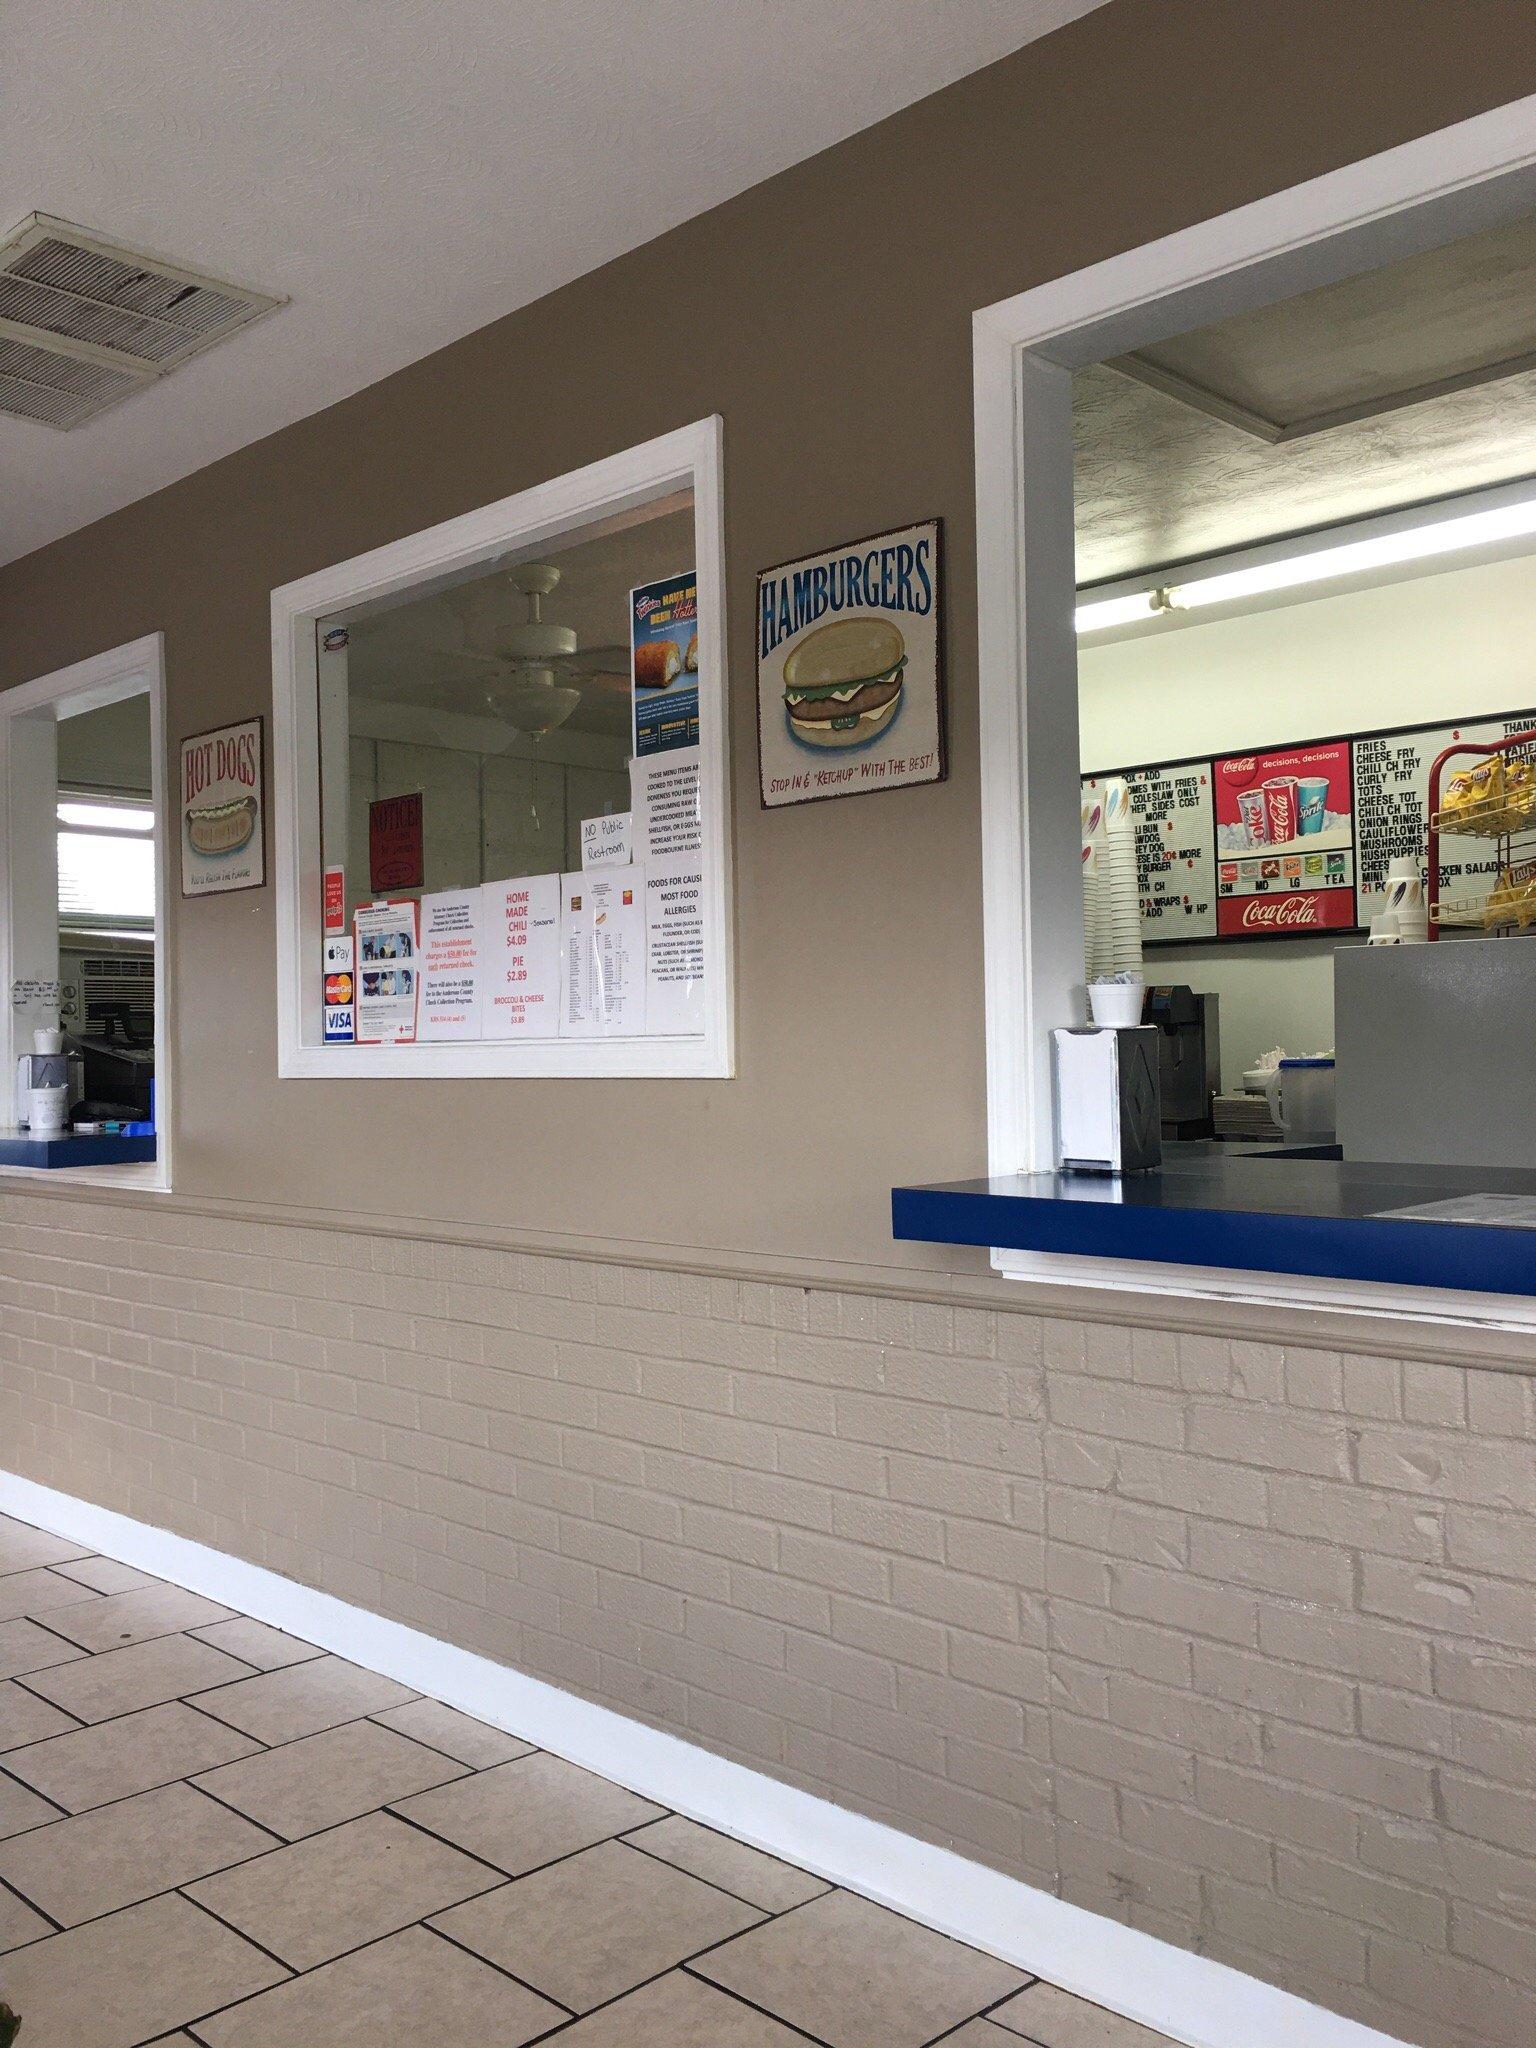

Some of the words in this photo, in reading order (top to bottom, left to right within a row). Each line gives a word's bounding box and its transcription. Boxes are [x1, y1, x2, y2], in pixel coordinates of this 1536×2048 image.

[761, 539, 931, 659] HAMBURGERS
[672, 599, 697, 619] Hotte
[1357, 741, 1386, 753] FRIES
[1263, 757, 1300, 768] decisions,
[1303, 751, 1339, 762] decisions
[1356, 751, 1391, 764] CHEESE
[1397, 747, 1414, 759] FRY
[186, 742, 213, 803] HOT
[217, 733, 255, 786] DOGS
[649, 771, 662, 779] THESE
[663, 769, 677, 777] MENU
[678, 766, 691, 774] ITEMS
[1357, 763, 1381, 775] CHILI
[1386, 761, 1398, 771] CH
[1403, 758, 1421, 769] FRY
[770, 778, 789, 793] STOP
[792, 775, 800, 789] IN
[804, 771, 810, 789] &
[813, 767, 859, 786] "KETCHUP"
[861, 762, 885, 777] WITH
[888, 759, 905, 775] THE
[909, 753, 933, 772] BEST!
[1144, 771, 1160, 781] ADD
[1357, 773, 1387, 786] CURLY
[1395, 770, 1412, 781] FRY
[647, 783, 666, 791] COOKED
[1151, 781, 1171, 791] WITH
[1175, 777, 1197, 787] FRIES
[1200, 776, 1206, 784] &
[1133, 794, 1173, 803] COLESLAW
[1178, 787, 1197, 797] ONLY
[1358, 785, 1382, 796] TOTS
[647, 793, 671, 801] DONENESS
[1358, 794, 1394, 807] CHEESE
[1399, 792, 1416, 802] TOT
[652, 803, 680, 811] CONSUMING
[1152, 800, 1175, 811] SIDES
[1179, 797, 1200, 807] COST
[1300, 801, 1324, 819] Sprite
[1359, 806, 1383, 818] CHILI
[1388, 804, 1400, 815] CH
[1405, 802, 1422, 813] TOT
[650, 812, 684, 823] UNDERCOOKED
[1146, 811, 1167, 821] MORE
[1359, 816, 1388, 828] ONION
[1393, 813, 1422, 825] RINGS
[585, 824, 596, 837] NO
[602, 821, 624, 834] Public
[673, 823, 680, 831] OR
[1143, 824, 1158, 833] BUN
[650, 836, 671, 844] INCREASE
[1143, 833, 1160, 842] DOG
[1361, 835, 1423, 850] MUSHROOMS
[588, 843, 625, 860] Restroom
[1150, 843, 1164, 852] DOG
[1361, 846, 1429, 861] HUSHPUPPIES
[1153, 853, 1160, 861] IS
[1179, 849, 1201, 859] MORE
[1143, 862, 1171, 872] BURGER
[648, 879, 668, 888] FOODS
[669, 877, 682, 885] FOR
[1362, 871, 1382, 882] MINI
[1155, 882, 1164, 891] CH
[1220, 884, 1232, 893] SM
[1256, 881, 1268, 890] MD
[1290, 878, 1300, 887] LG
[1324, 874, 1345, 884] TEA
[1362, 883, 1371, 893] 21
[507, 892, 529, 903] HOME
[661, 892, 678, 901] MOST
[681, 890, 698, 899] FOOD
[1154, 896, 1180, 906] WRAPS
[506, 906, 528, 918] MADE
[664, 905, 696, 915] ALLERGIES
[1146, 908, 1162, 917] ADD
[1185, 906, 1192, 914] W
[1197, 904, 1208, 913] HP
[1243, 896, 1319, 927] Coca-Cola
[509, 921, 527, 931] CHILI
[507, 935, 526, 947] $4.09
[336, 946, 349, 966] Pay
[513, 956, 524, 966] PIE
[507, 971, 527, 982] $2.89
[326, 985, 352, 994] MasterCard
[494, 996, 519, 1004] BROCCOLI
[520, 995, 524, 1003] &
[525, 994, 544, 1003] CHEESE
[329, 1013, 351, 1028] VISA
